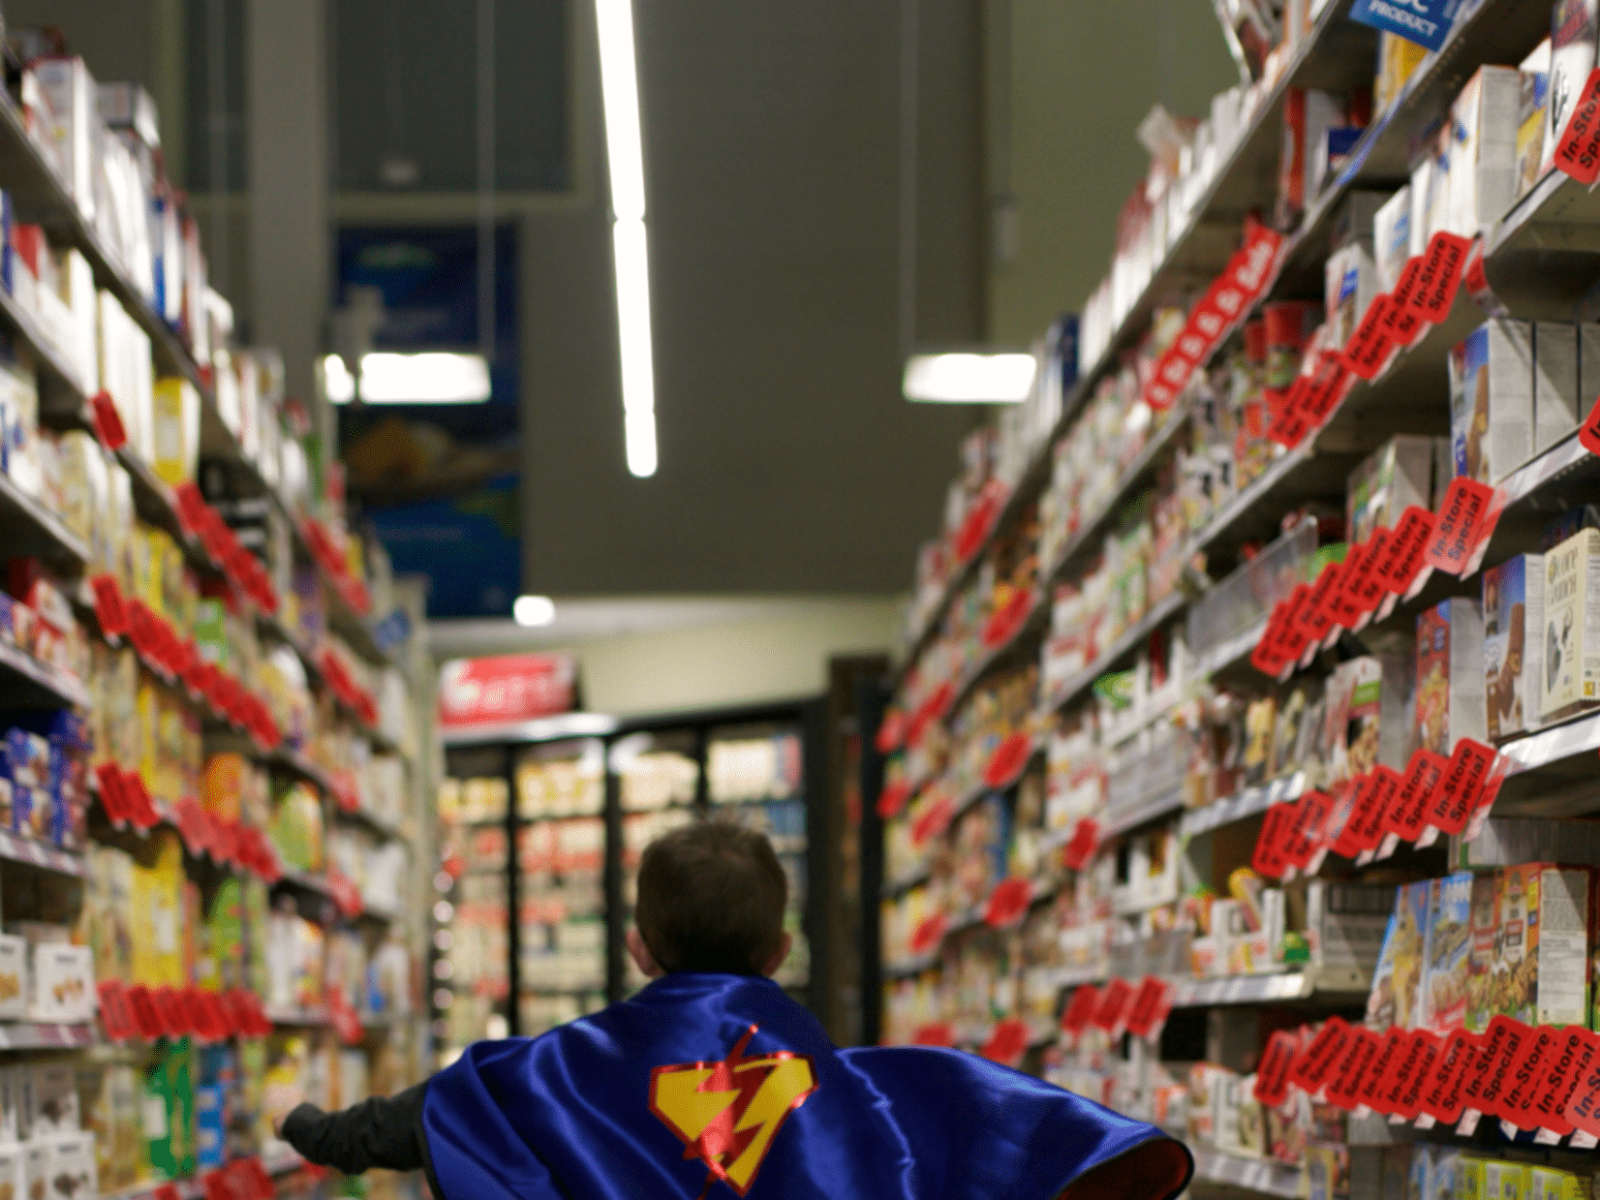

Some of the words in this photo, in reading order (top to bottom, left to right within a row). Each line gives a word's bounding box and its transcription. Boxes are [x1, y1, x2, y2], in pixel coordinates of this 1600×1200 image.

[1369, 0, 1438, 37] PRODUCT
[1411, 238, 1446, 307] In-Store
[1428, 244, 1461, 311] Special
[1378, 514, 1419, 577] In-Store
[1392, 522, 1432, 581] Special
[1431, 487, 1467, 557] In-Store
[1448, 493, 1482, 561] Special
[1390, 758, 1428, 823] In-Store
[1405, 765, 1442, 828] Special
[1433, 747, 1472, 818] In-Store
[1450, 753, 1485, 822] Special
[1387, 1038, 1424, 1103] In-Store
[1426, 1037, 1465, 1107] In-Store
[1465, 1025, 1507, 1098] In-Store
[1482, 1031, 1521, 1102] Special
[1503, 1033, 1550, 1108] In-Store
[1536, 1034, 1579, 1114] In-Store
